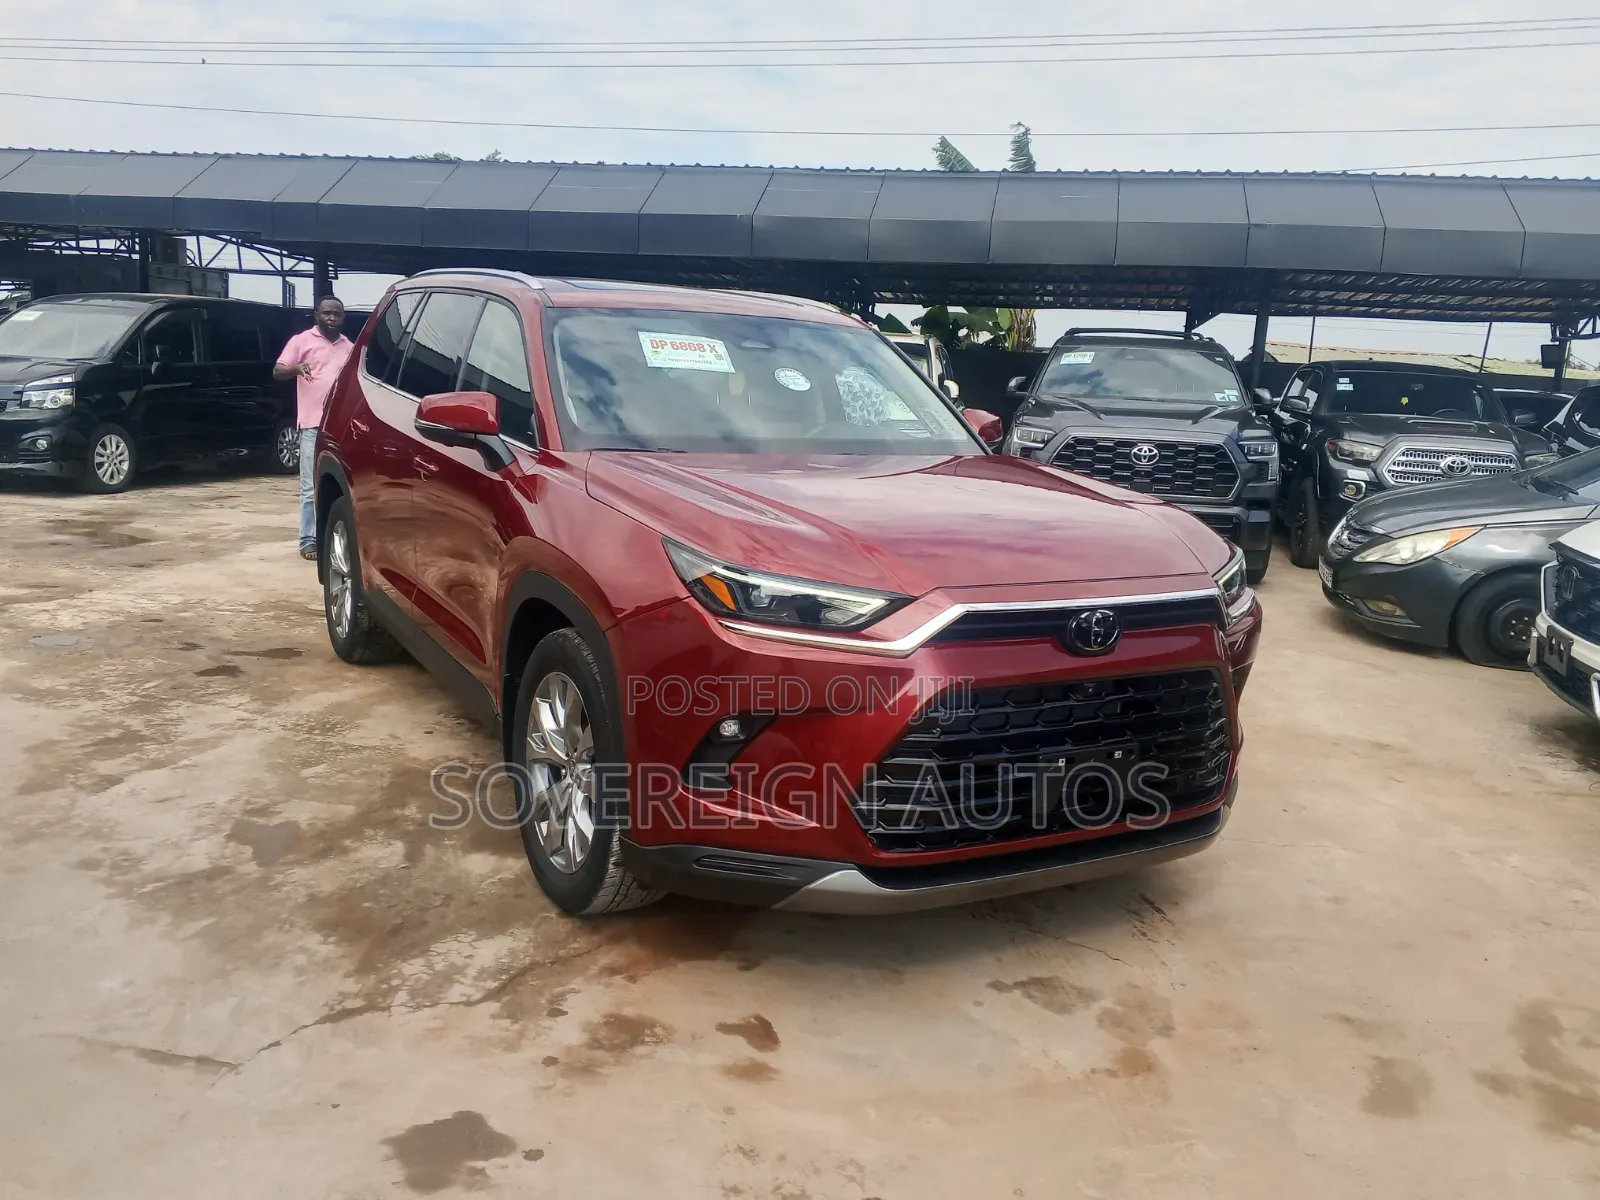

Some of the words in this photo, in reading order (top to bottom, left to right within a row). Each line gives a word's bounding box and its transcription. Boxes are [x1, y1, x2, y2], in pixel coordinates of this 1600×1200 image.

[649, 339, 668, 350] DP
[669, 341, 706, 353] 6868
[708, 344, 719, 353] X
